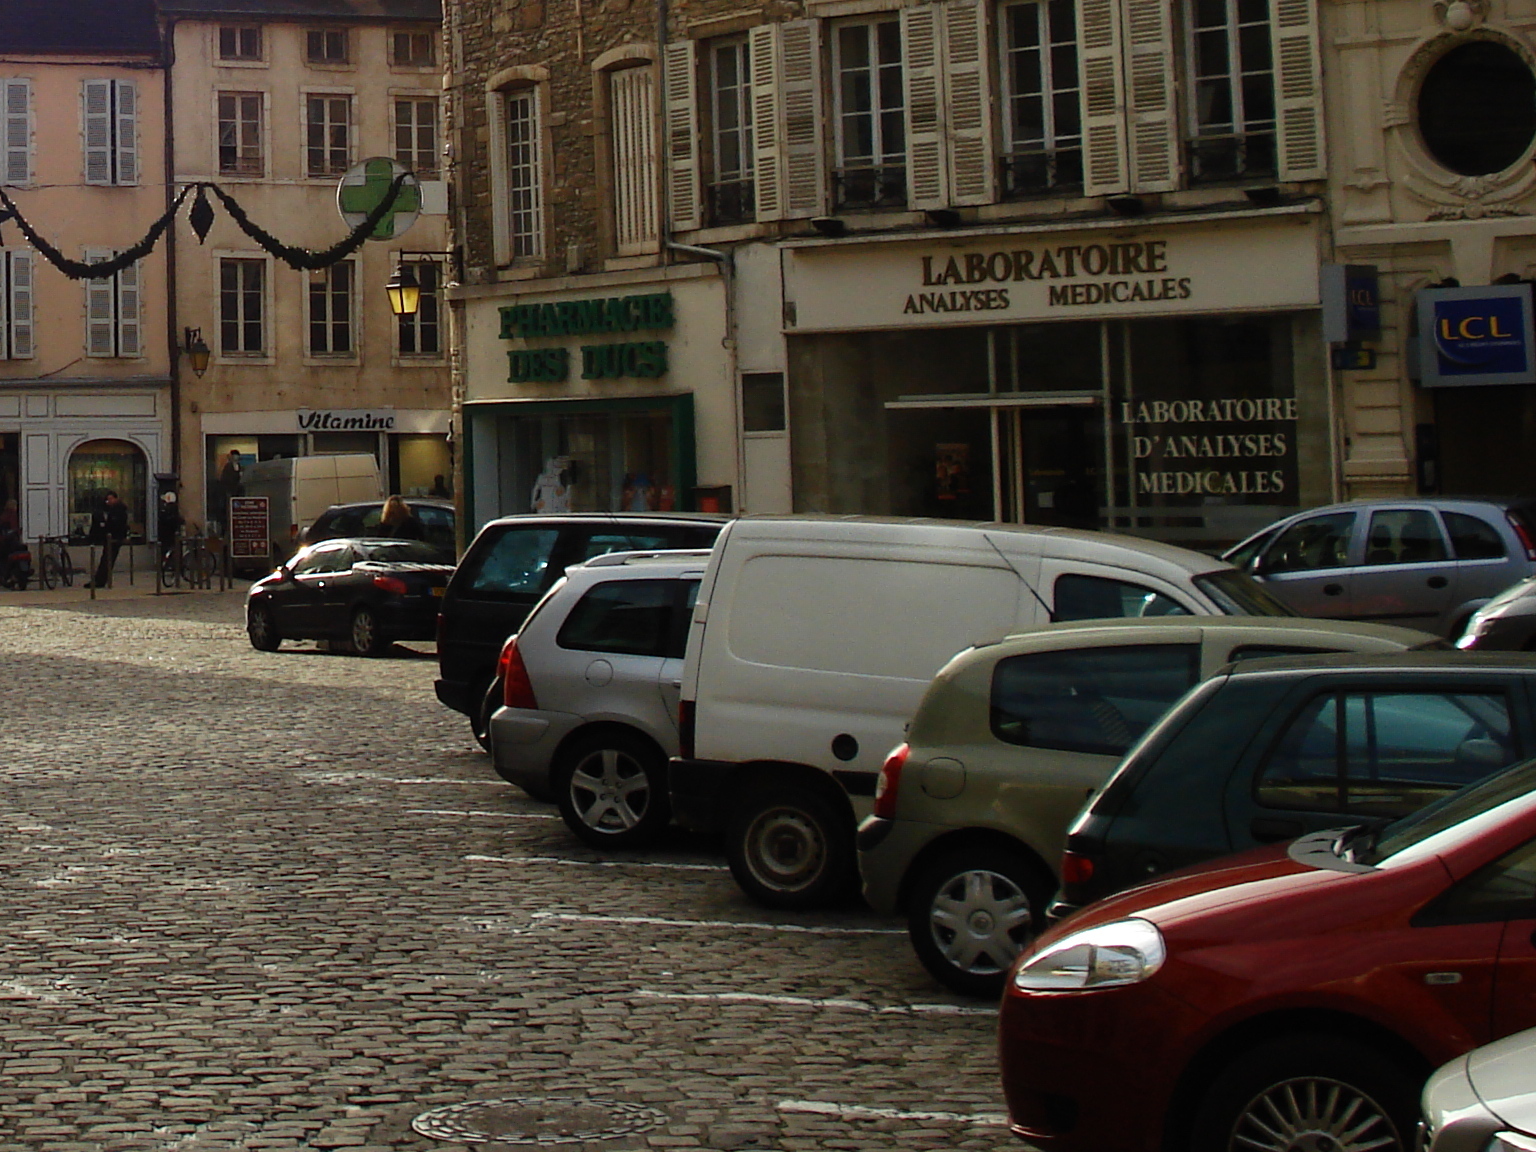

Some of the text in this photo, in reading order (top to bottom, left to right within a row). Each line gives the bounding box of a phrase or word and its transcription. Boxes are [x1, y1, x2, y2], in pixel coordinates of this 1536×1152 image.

[921, 240, 1168, 286] LABORATOIRE
[903, 277, 1192, 314] ANALYSES MEDICALES
[498, 292, 675, 339] PHARMACIE
[1440, 315, 1512, 341] LCL
[507, 340, 669, 383] DES DUCS
[298, 411, 395, 429] Vitamine
[1121, 398, 1299, 424] LABORATOIRE
[1139, 470, 1285, 494] MEDICALES
